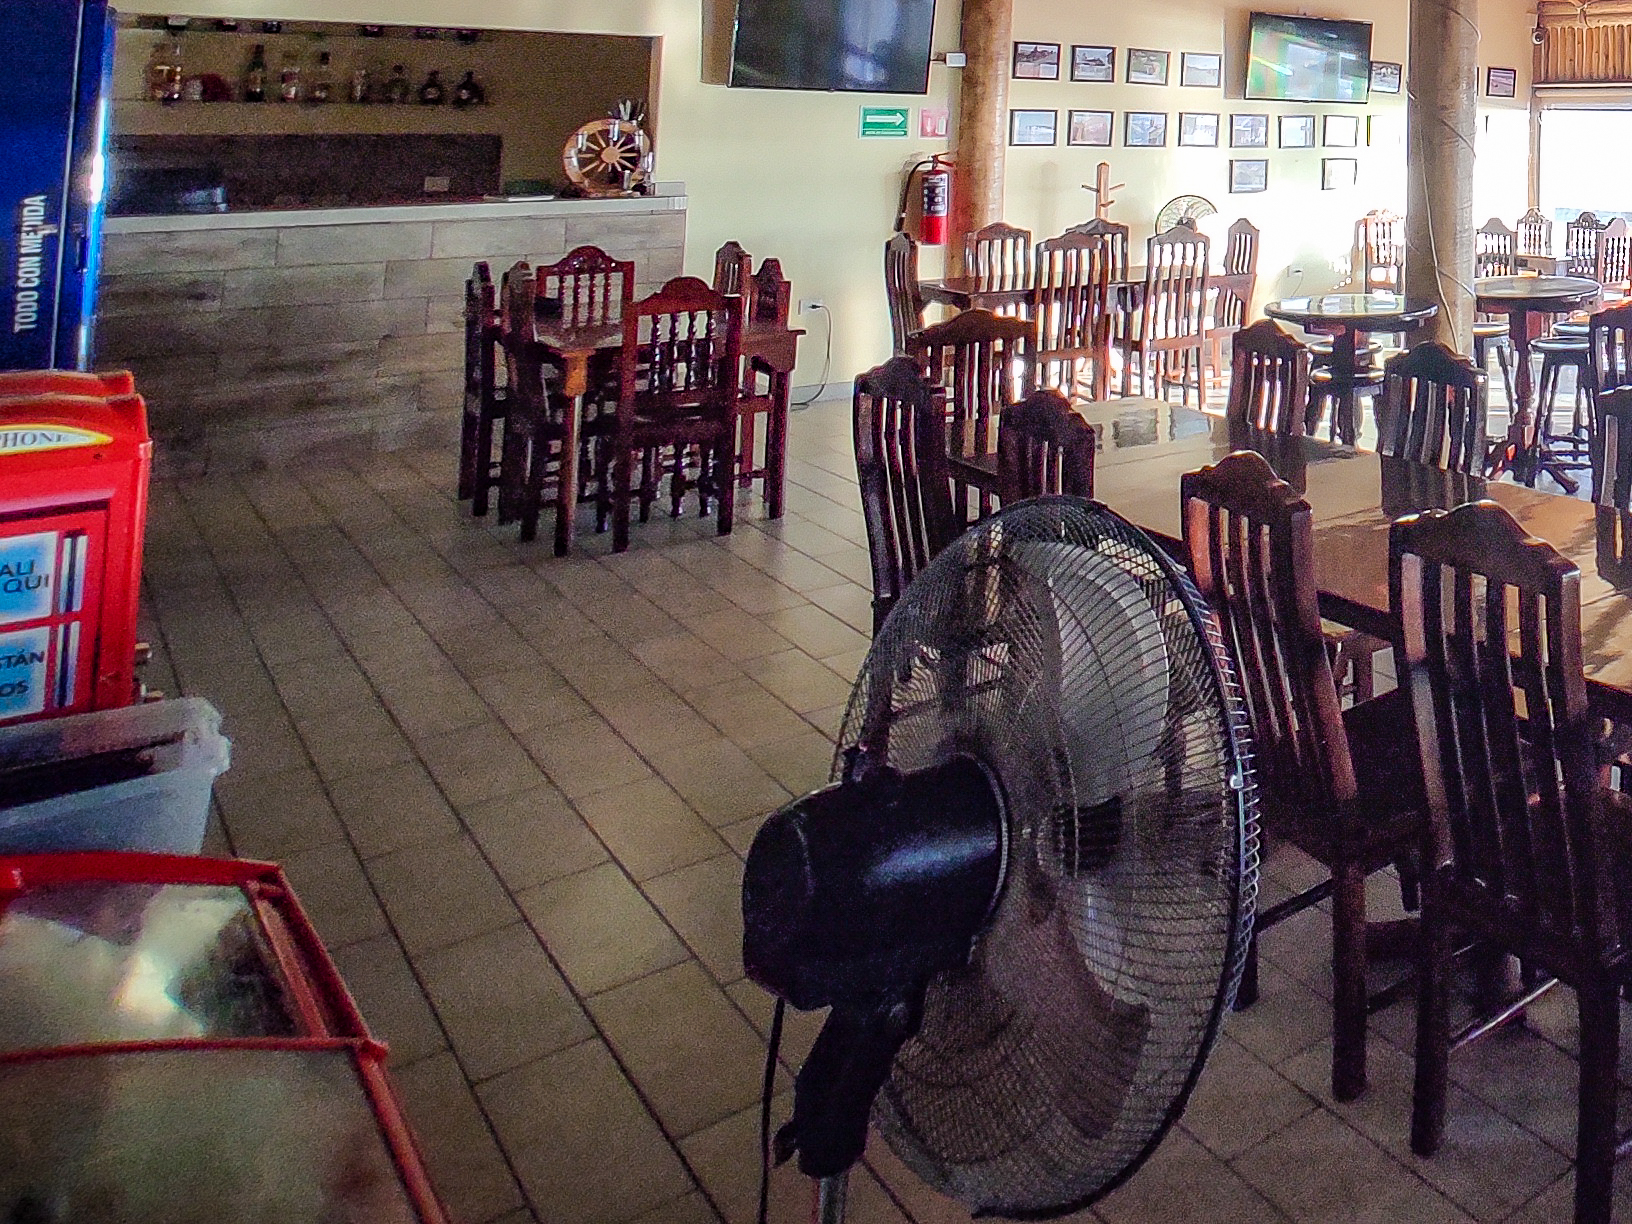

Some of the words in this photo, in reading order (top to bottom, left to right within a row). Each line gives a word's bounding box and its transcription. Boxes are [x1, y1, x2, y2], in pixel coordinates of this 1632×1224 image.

[17, 256, 42, 288] CON
[13, 290, 39, 333] TODO
[0, 648, 45, 669] TÁN
